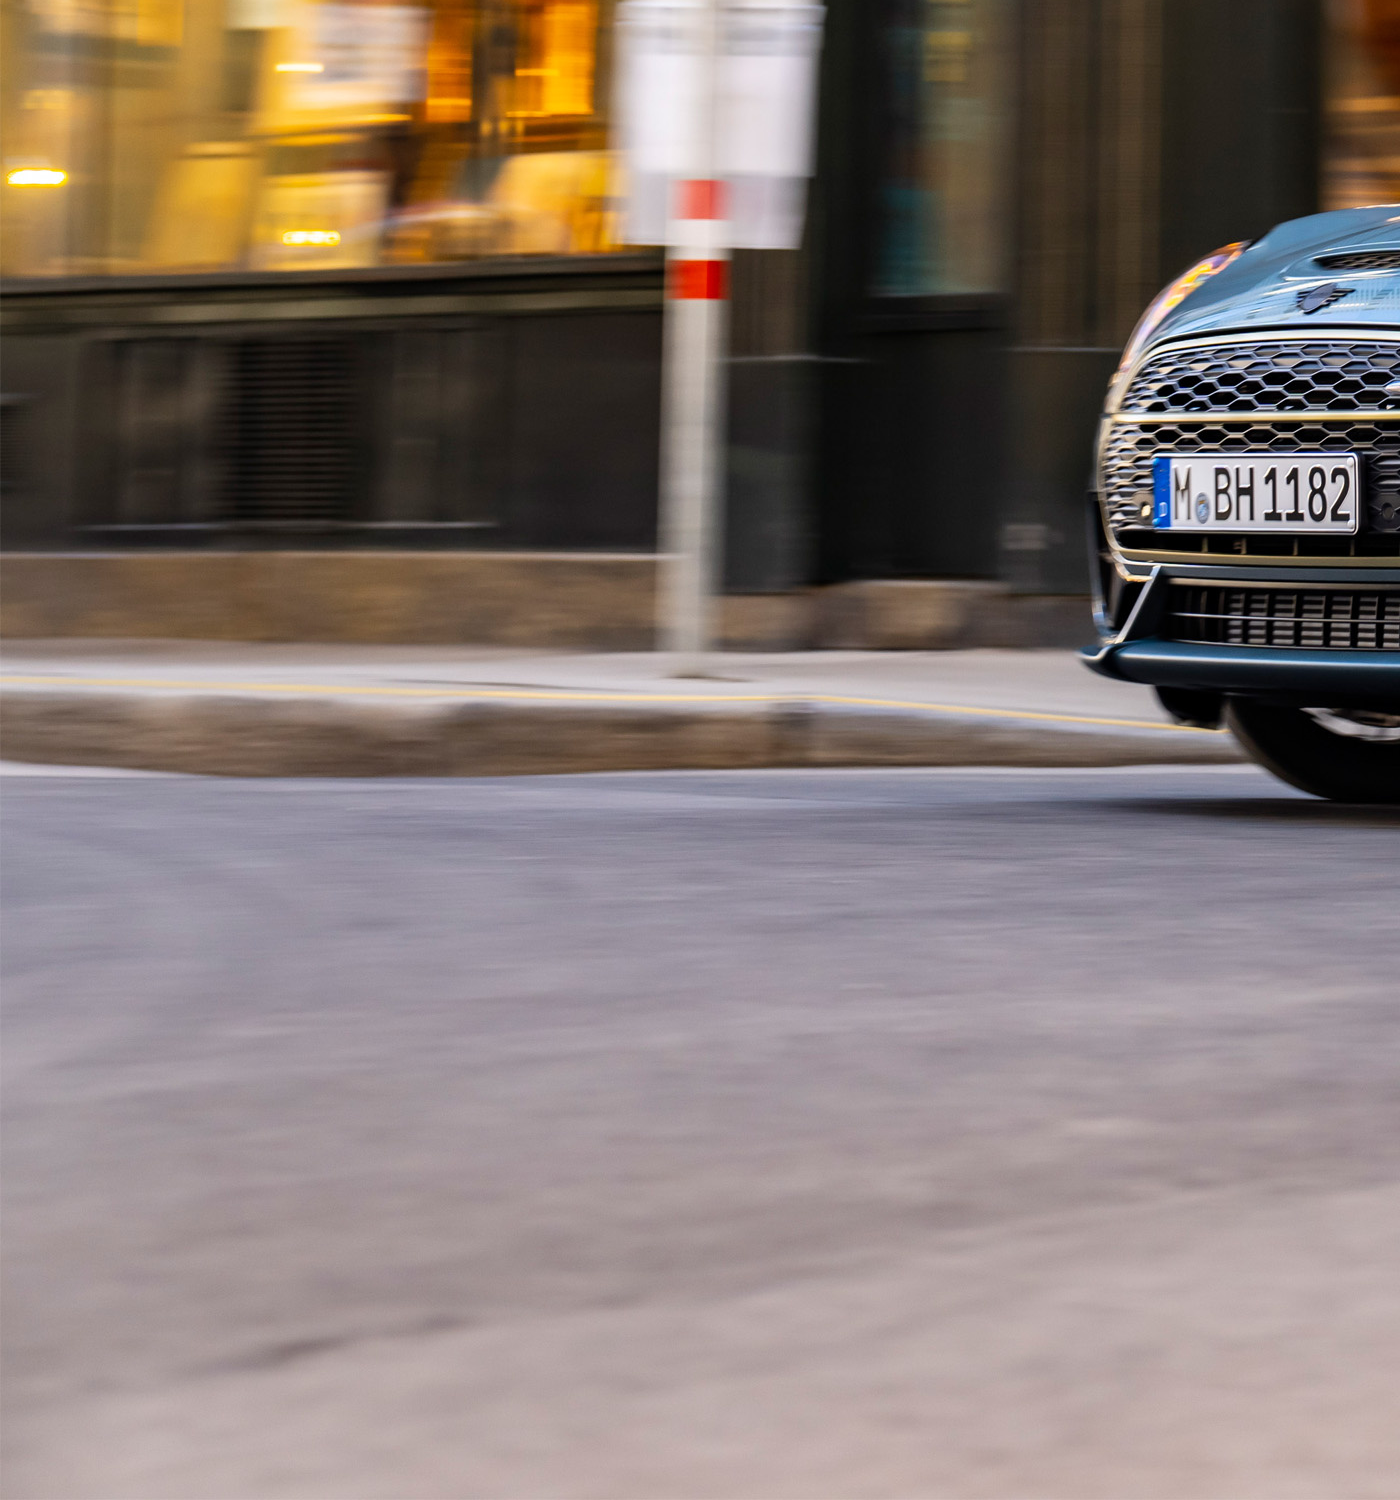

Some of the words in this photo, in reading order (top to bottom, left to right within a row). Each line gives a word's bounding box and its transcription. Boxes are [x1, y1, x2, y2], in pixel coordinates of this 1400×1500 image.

[1173, 466, 1192, 521] M
[1213, 466, 1255, 521] BH
[1263, 466, 1351, 522] 1182
